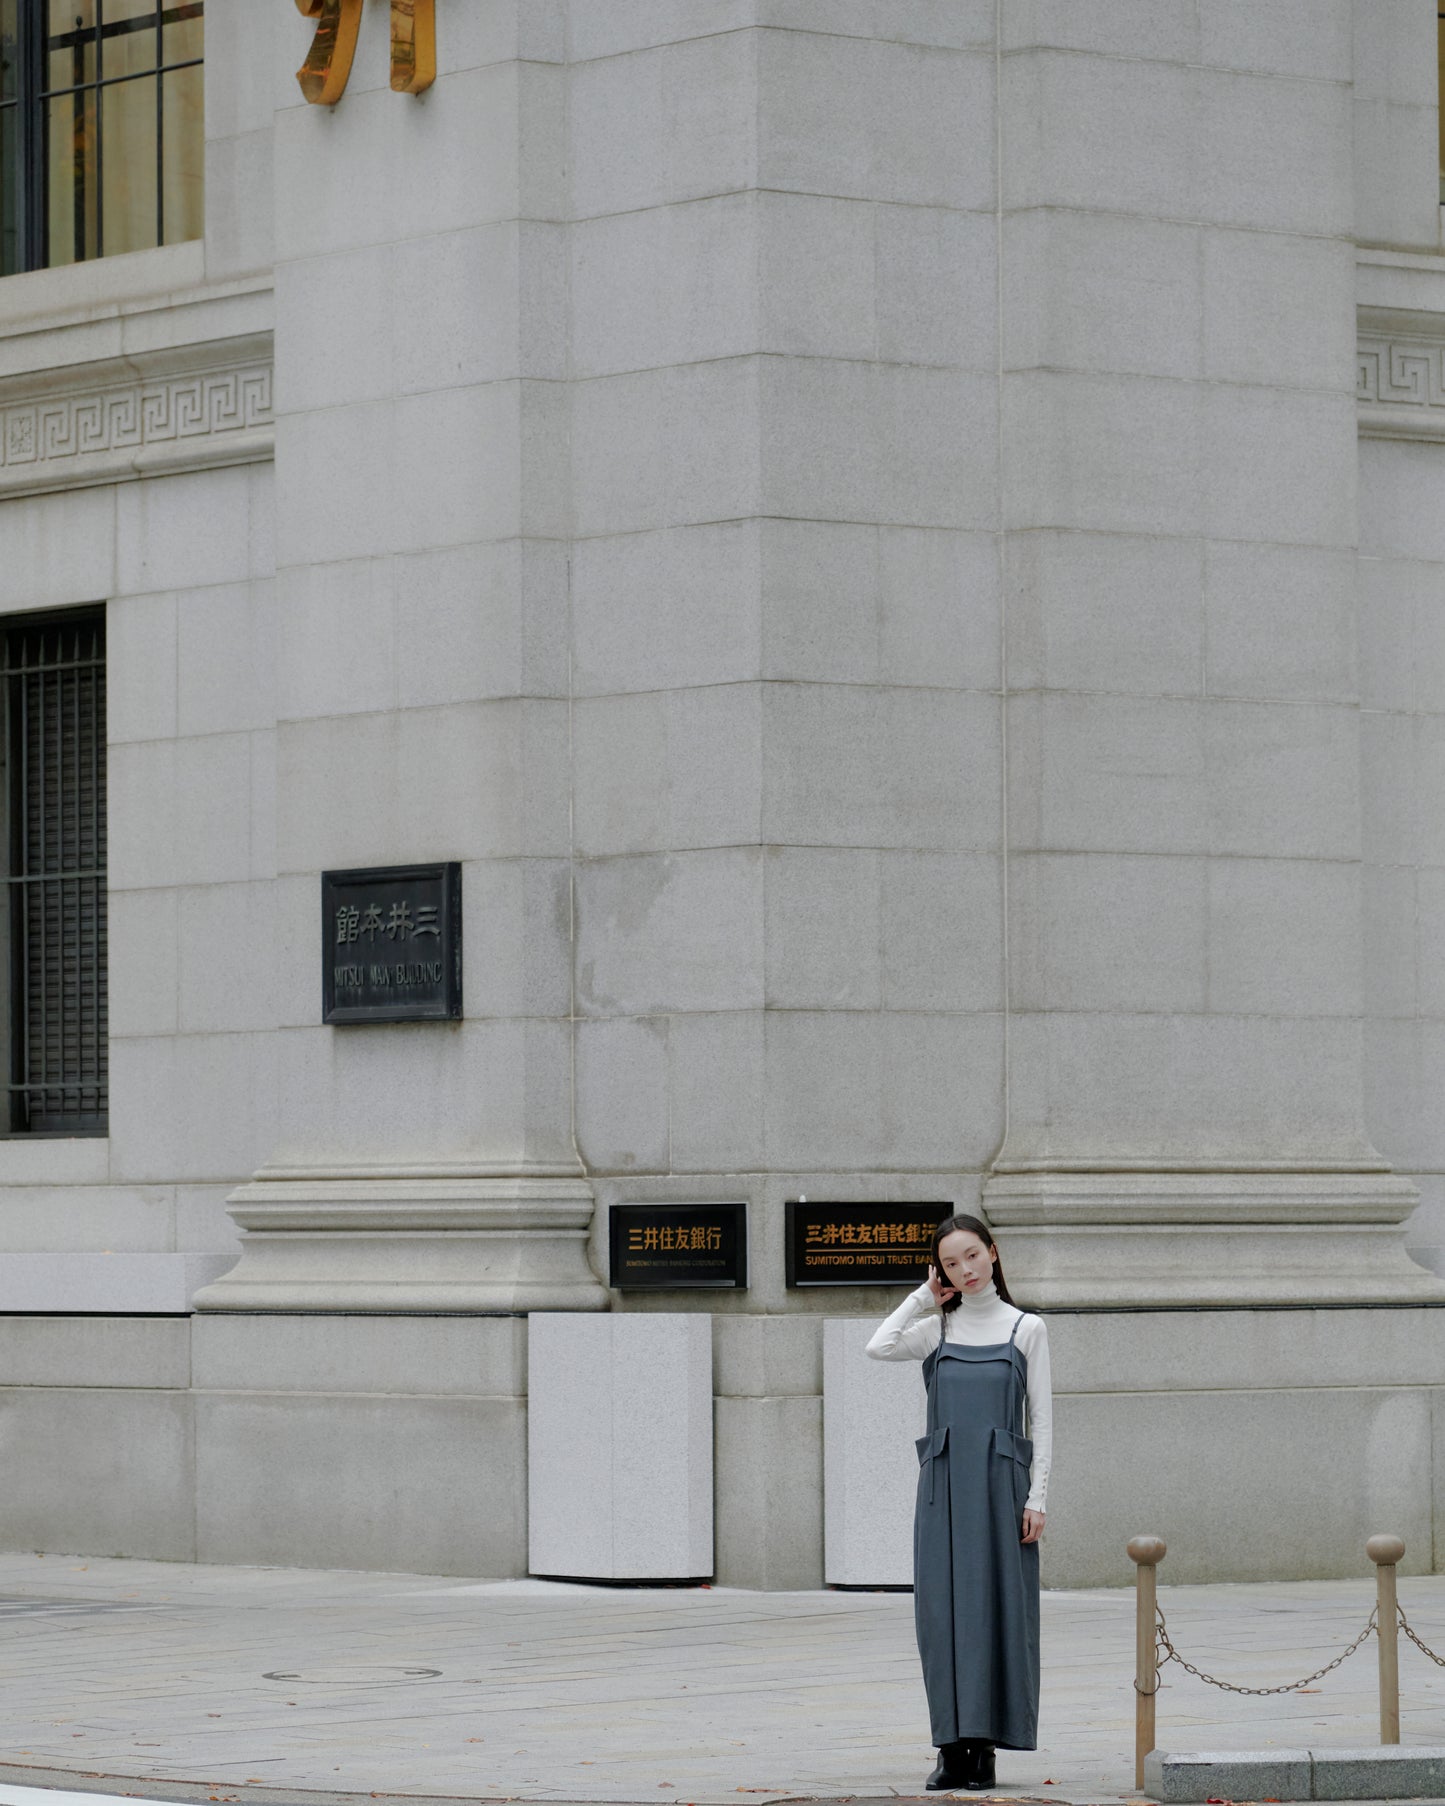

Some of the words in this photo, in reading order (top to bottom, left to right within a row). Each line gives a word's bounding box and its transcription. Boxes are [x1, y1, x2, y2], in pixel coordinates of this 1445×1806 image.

[628, 1226, 722, 1251] 三井住友銀行
[805, 1255, 854, 1266] SUMITOMO
[856, 1255, 885, 1265] MITSUI
[887, 1255, 913, 1265] TRUST
[915, 1255, 933, 1265] BAN
